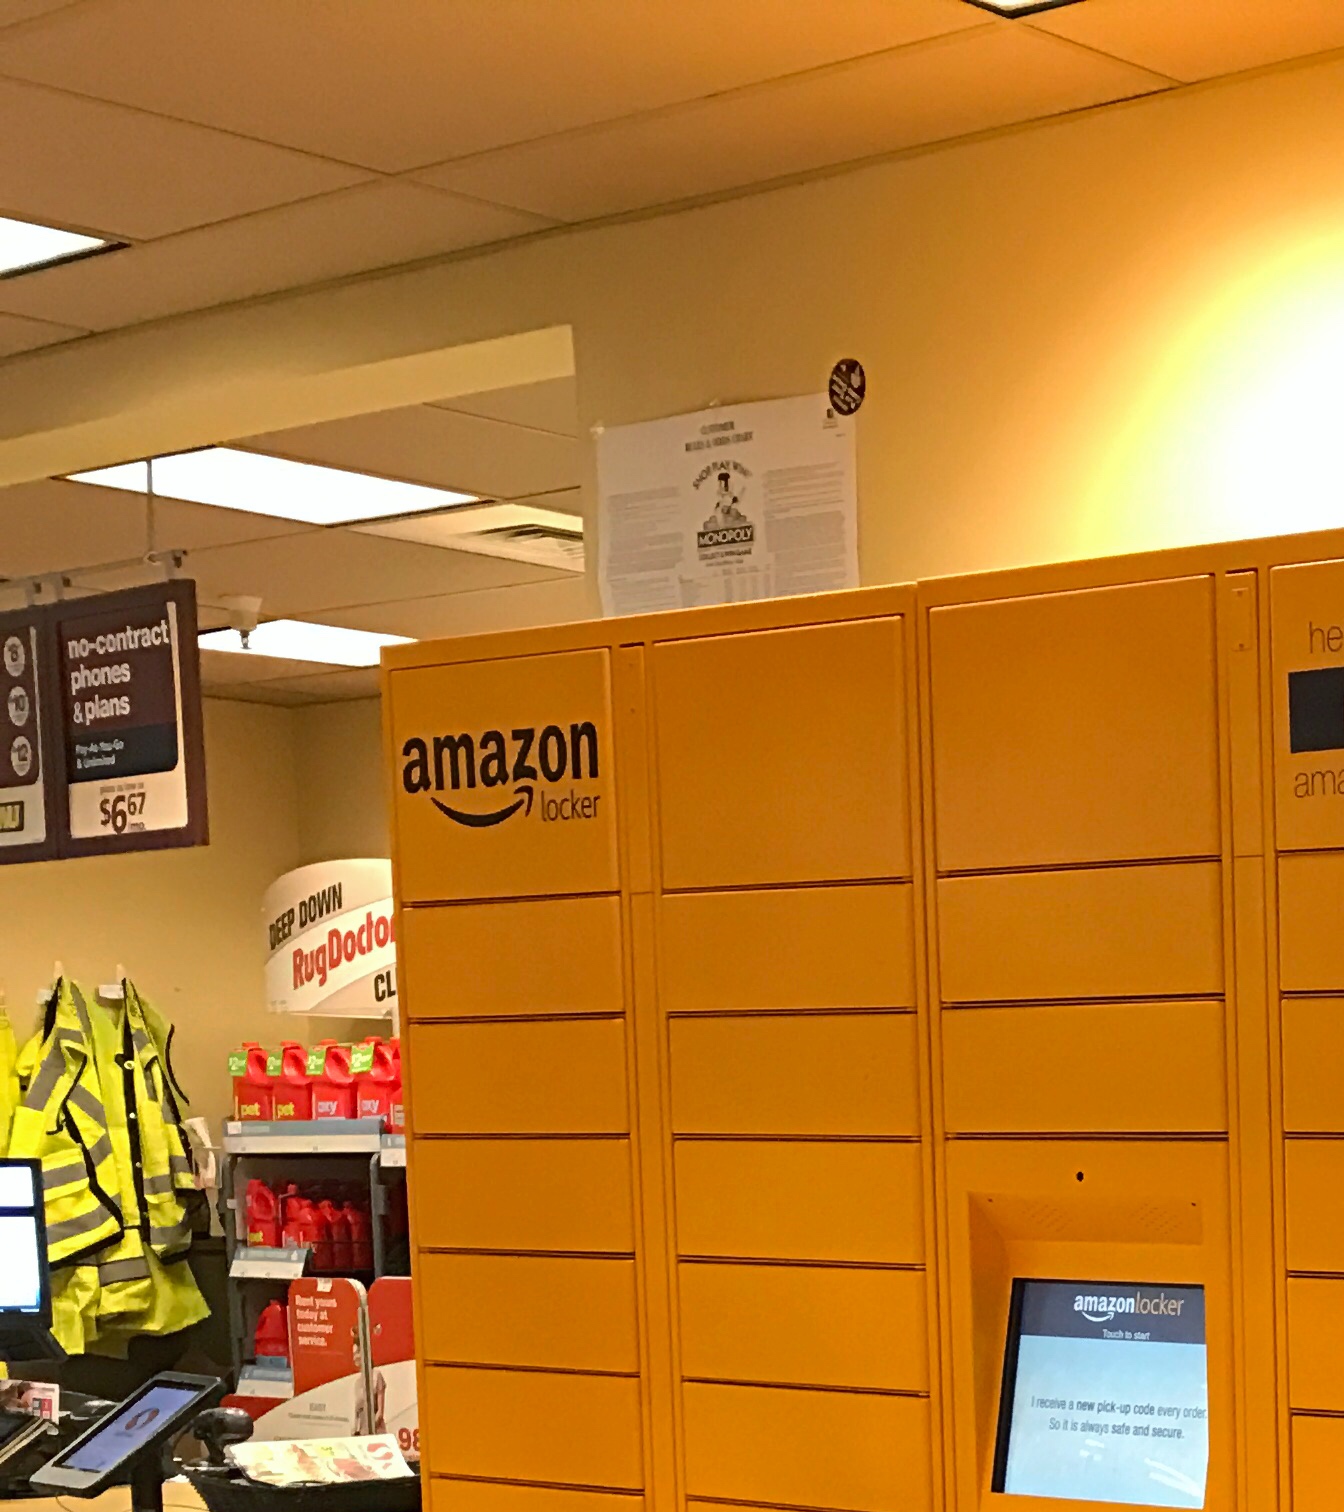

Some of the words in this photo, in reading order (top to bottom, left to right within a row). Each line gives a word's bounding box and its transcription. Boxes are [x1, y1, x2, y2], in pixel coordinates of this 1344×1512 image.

[68, 619, 170, 660] no-contract
[71, 662, 131, 695] phones
[73, 702, 83, 724] &
[85, 694, 131, 726] plans
[402, 721, 599, 793] amazon
[541, 789, 600, 822] locker
[269, 907, 295, 951] DEEP
[299, 882, 342, 928] DOWN
[1103, 1328, 1124, 1339] Touch
[1125, 1330, 1132, 1339] to
[1134, 1330, 1150, 1341] start
[1037, 1398, 1067, 1410] receive
[1069, 1401, 1074, 1410] a
[1076, 1401, 1095, 1412] new
[1097, 1400, 1131, 1415] pick-up
[1133, 1403, 1155, 1416] code
[1157, 1406, 1181, 1420] every
[1049, 1417, 1061, 1430] So
[1063, 1418, 1068, 1430] it
[1071, 1420, 1078, 1431] is
[1080, 1420, 1109, 1436] always
[1111, 1422, 1130, 1434] safe
[1132, 1424, 1150, 1437] and
[1152, 1427, 1185, 1440] secure.
